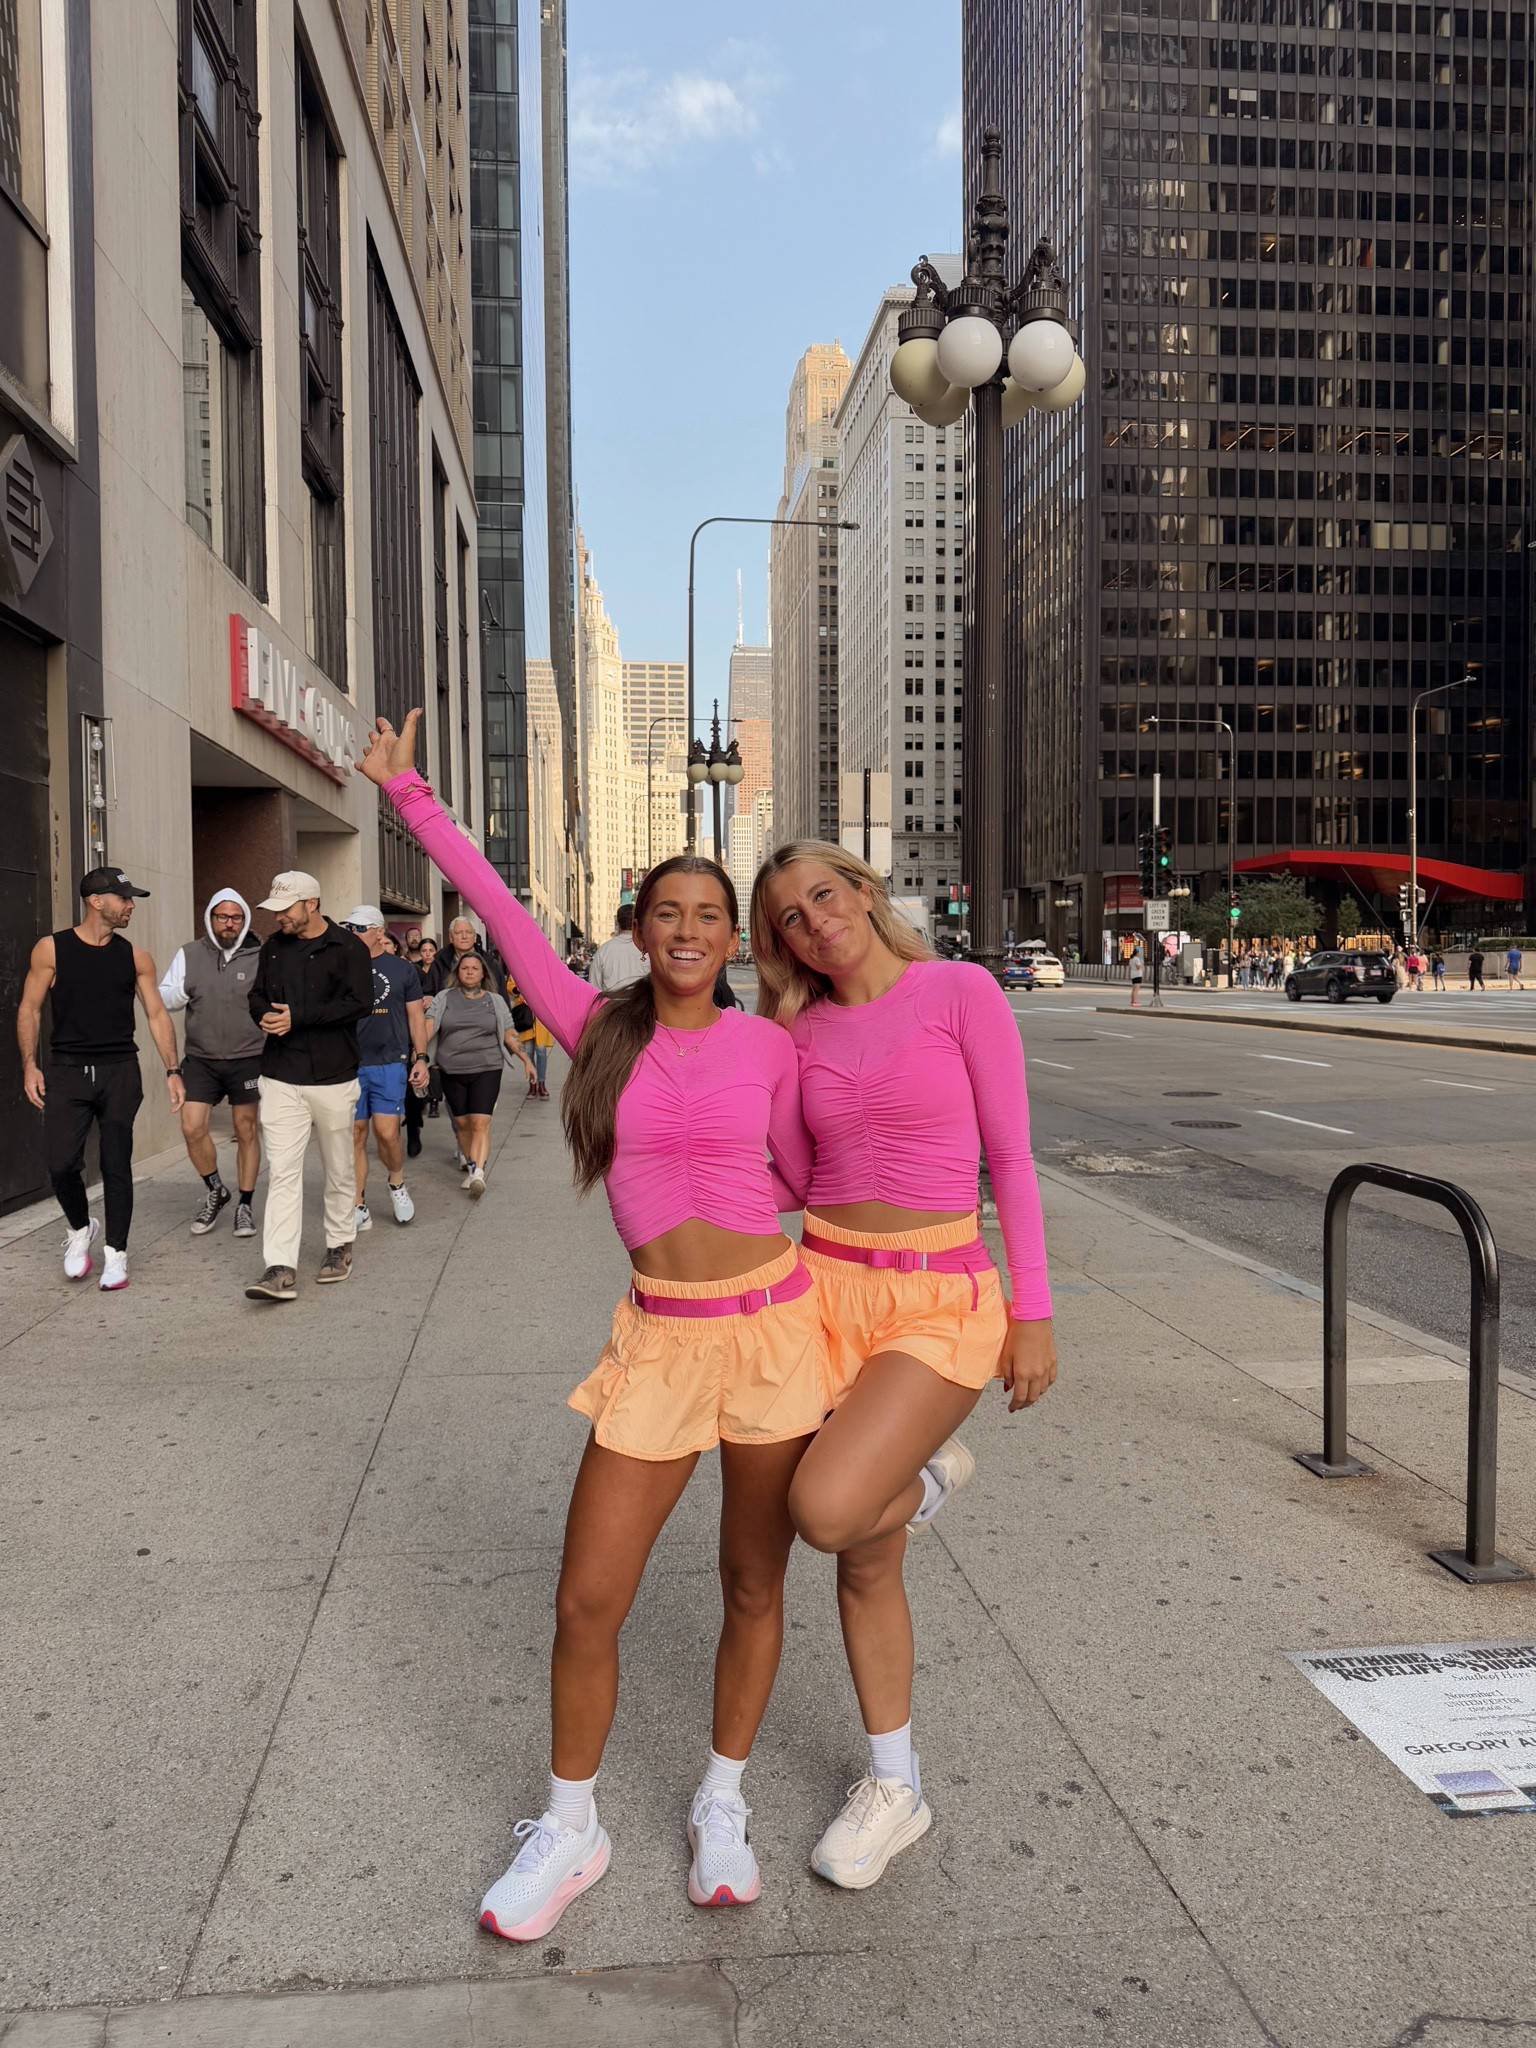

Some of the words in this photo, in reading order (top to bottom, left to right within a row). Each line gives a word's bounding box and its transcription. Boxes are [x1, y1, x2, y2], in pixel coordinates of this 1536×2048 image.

[378, 972, 390, 984] NEW
[379, 984, 391, 1001] YORK
[1303, 1652, 1439, 1670] NATHANIEL
[1330, 1661, 1445, 1683] RATELIFF
[1451, 1673, 1486, 1682] South
[1488, 1672, 1500, 1681] of
[1500, 1671, 1531, 1679] Here
[1404, 1737, 1510, 1756] GREGORY
